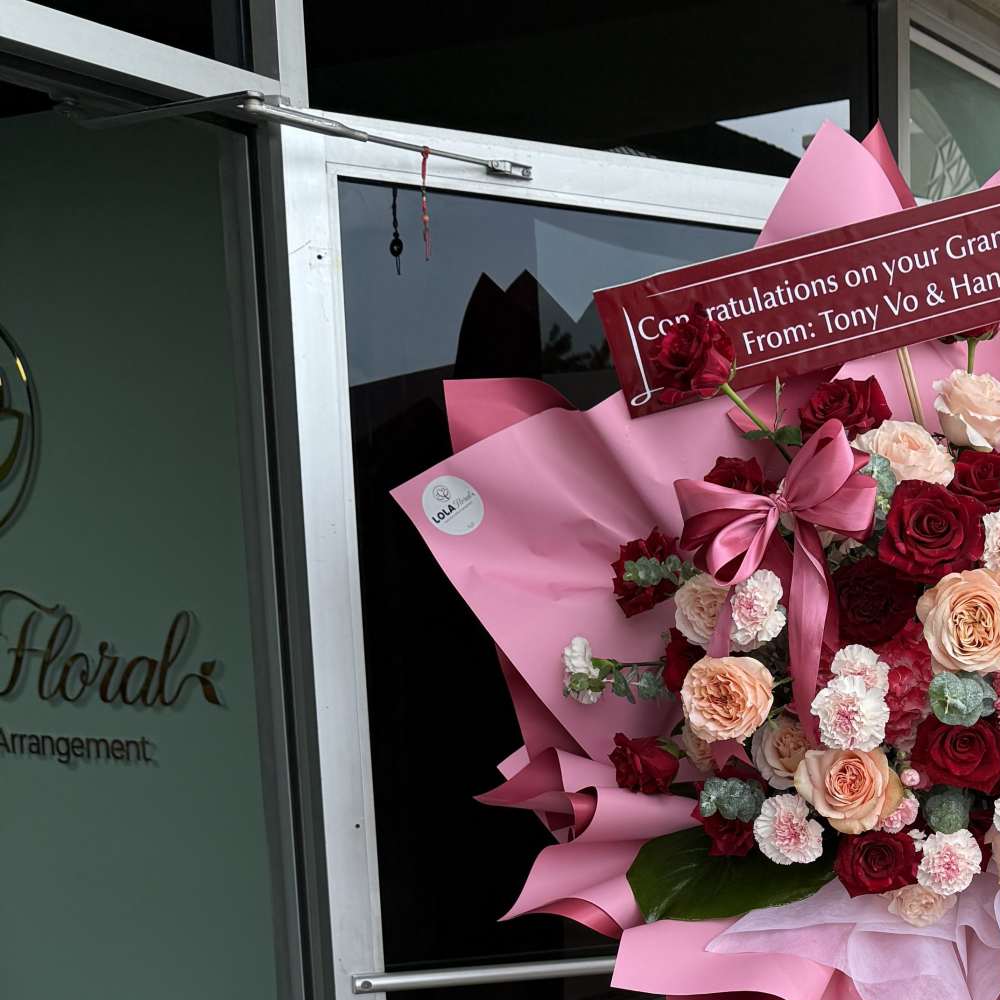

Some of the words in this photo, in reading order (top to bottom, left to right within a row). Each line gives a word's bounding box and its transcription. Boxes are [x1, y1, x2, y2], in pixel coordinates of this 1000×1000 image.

[637, 275, 839, 341] Conratulations
[845, 264, 878, 287] on
[881, 246, 940, 286] your
[742, 325, 816, 356] From:
[818, 303, 880, 334] Tony
[883, 291, 919, 317] Vo
[926, 282, 946, 307] &
[431, 504, 457, 524] LOLA
[0, 589, 216, 707] Floral
